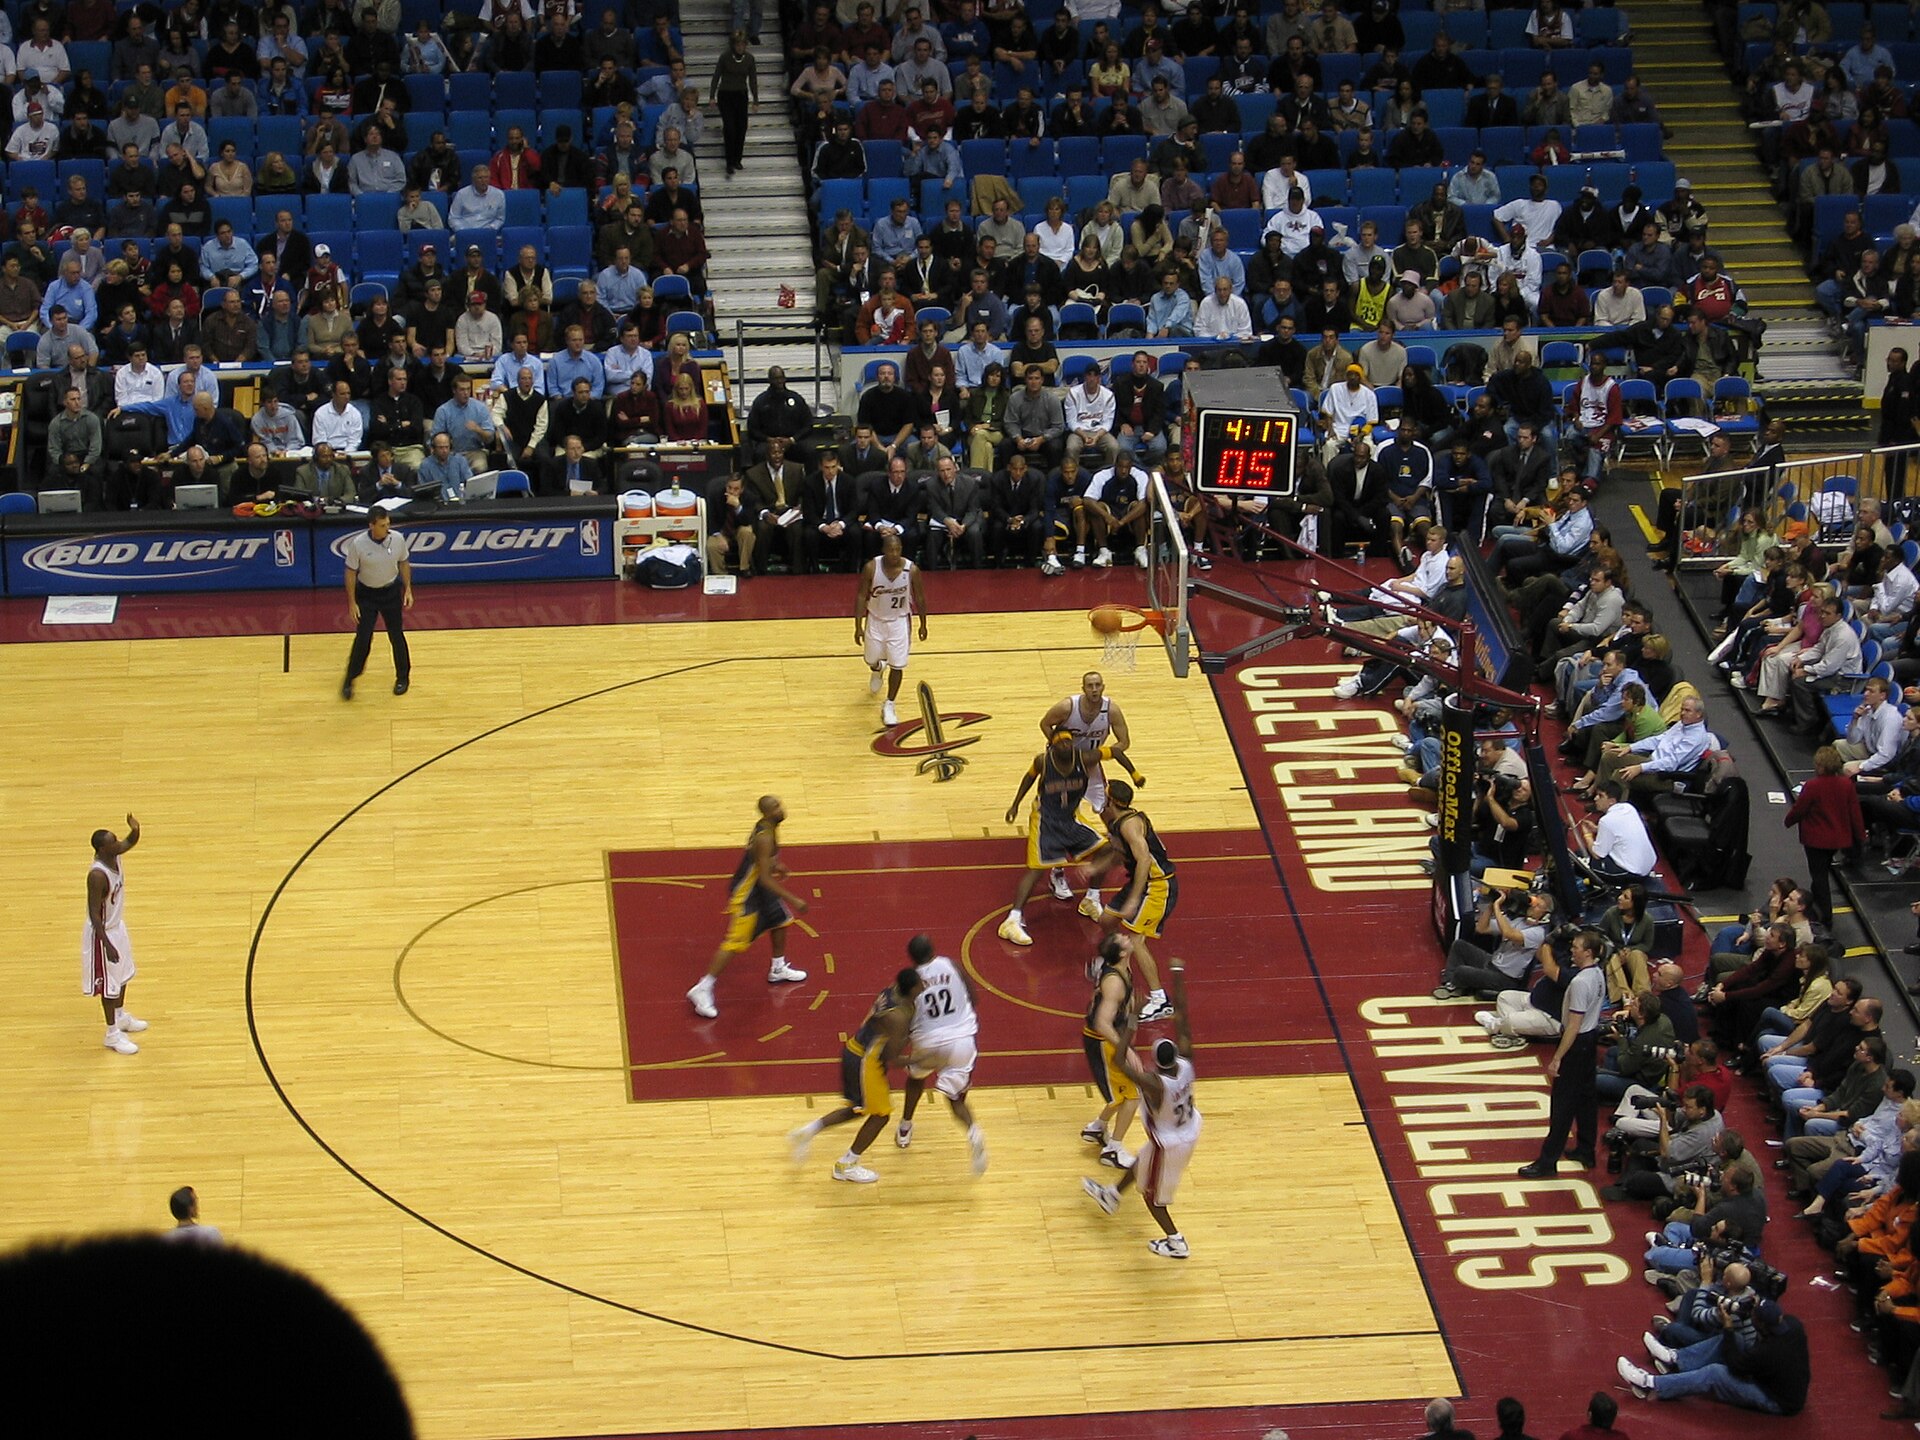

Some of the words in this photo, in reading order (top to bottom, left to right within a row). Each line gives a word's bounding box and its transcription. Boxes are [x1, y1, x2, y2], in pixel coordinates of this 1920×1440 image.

[1226, 419, 1289, 443] 4:17
[1217, 448, 1276, 487] 05
[47, 543, 139, 567] BUD
[143, 537, 269, 563] LIGHT
[450, 526, 576, 551] LIGHT
[1237, 664, 1434, 892] CLEVELAND
[1444, 731, 1462, 843] OfficeMax
[924, 989, 956, 1018] 32
[1358, 995, 1632, 1291] CAVALIERS
